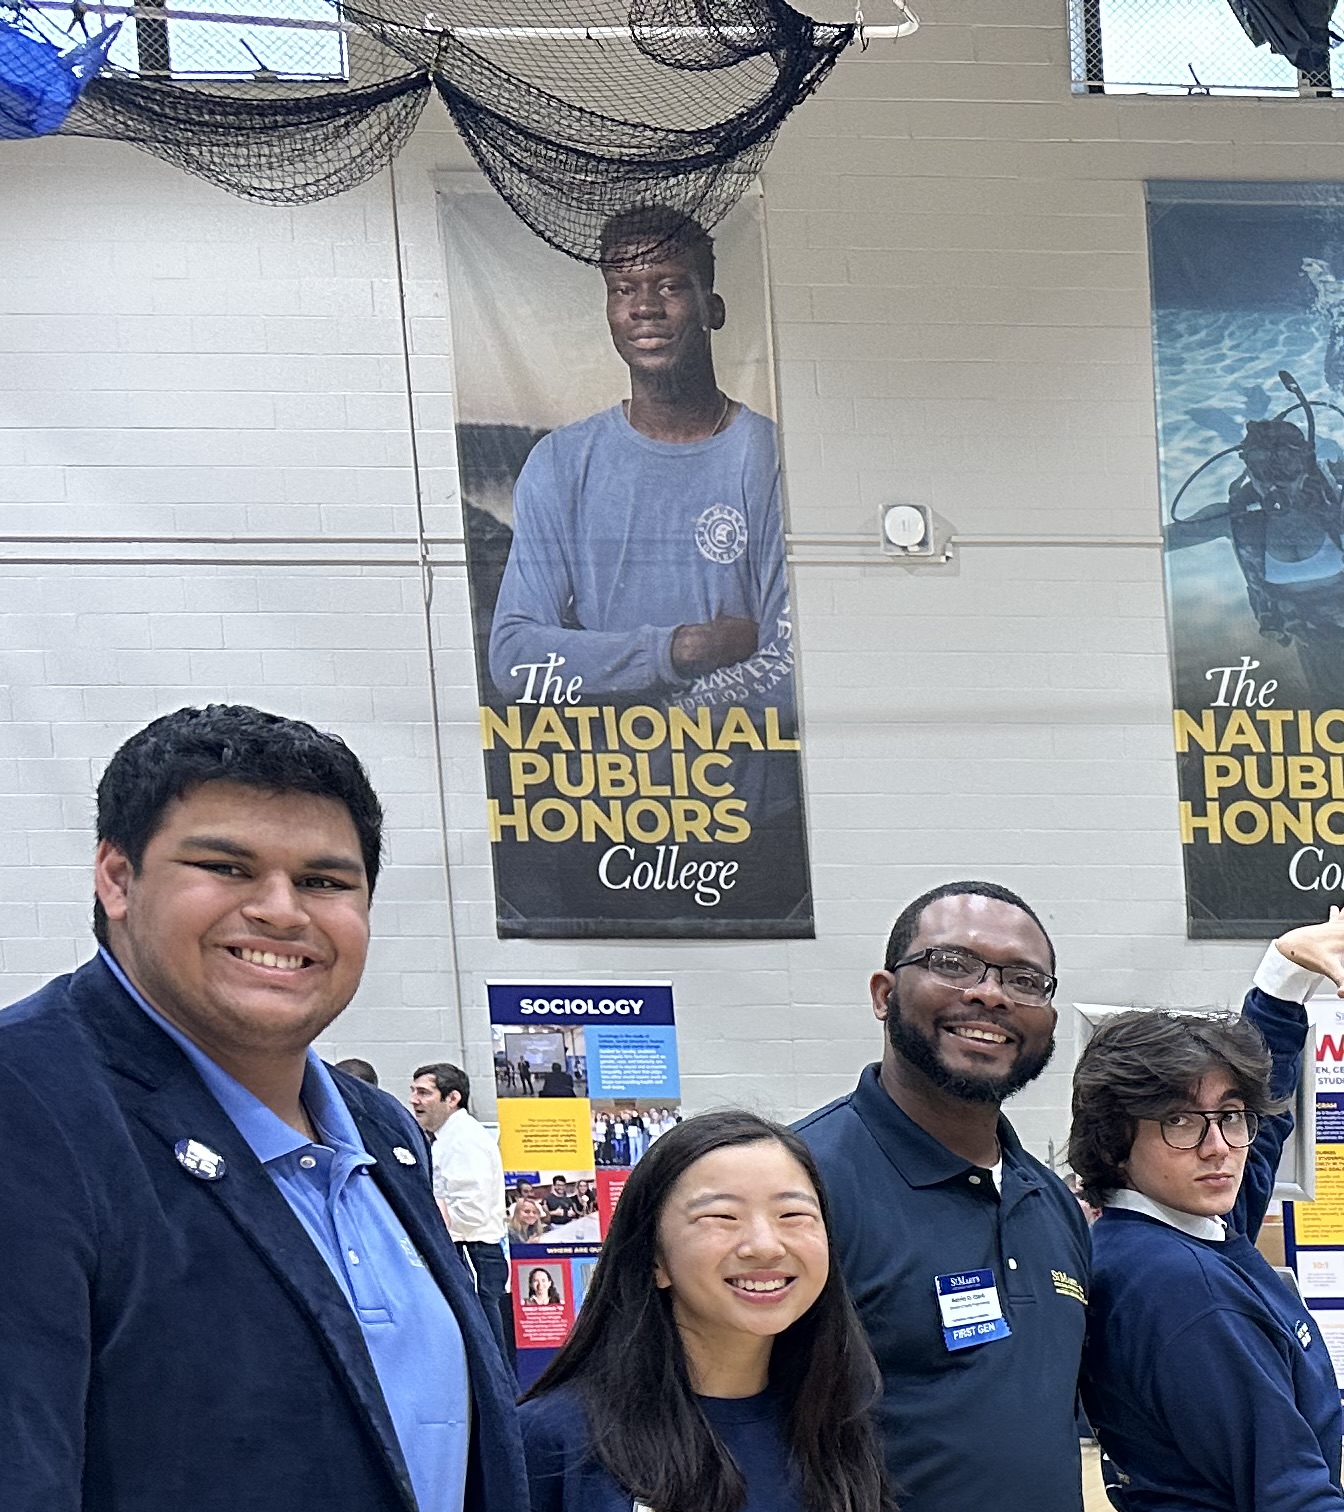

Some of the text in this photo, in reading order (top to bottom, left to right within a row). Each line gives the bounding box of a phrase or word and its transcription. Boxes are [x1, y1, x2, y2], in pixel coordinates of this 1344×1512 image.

[511, 652, 583, 705] The
[1205, 656, 1278, 707] The
[479, 706, 800, 751] NATIONAL
[509, 752, 735, 797] PUBLIC
[487, 799, 751, 843] HONORS
[598, 845, 739, 906] College
[520, 999, 643, 1015] SOCIOLOGY
[1316, 1066, 1330, 1075] EN,
[953, 1322, 996, 1340] FIRST GEN
